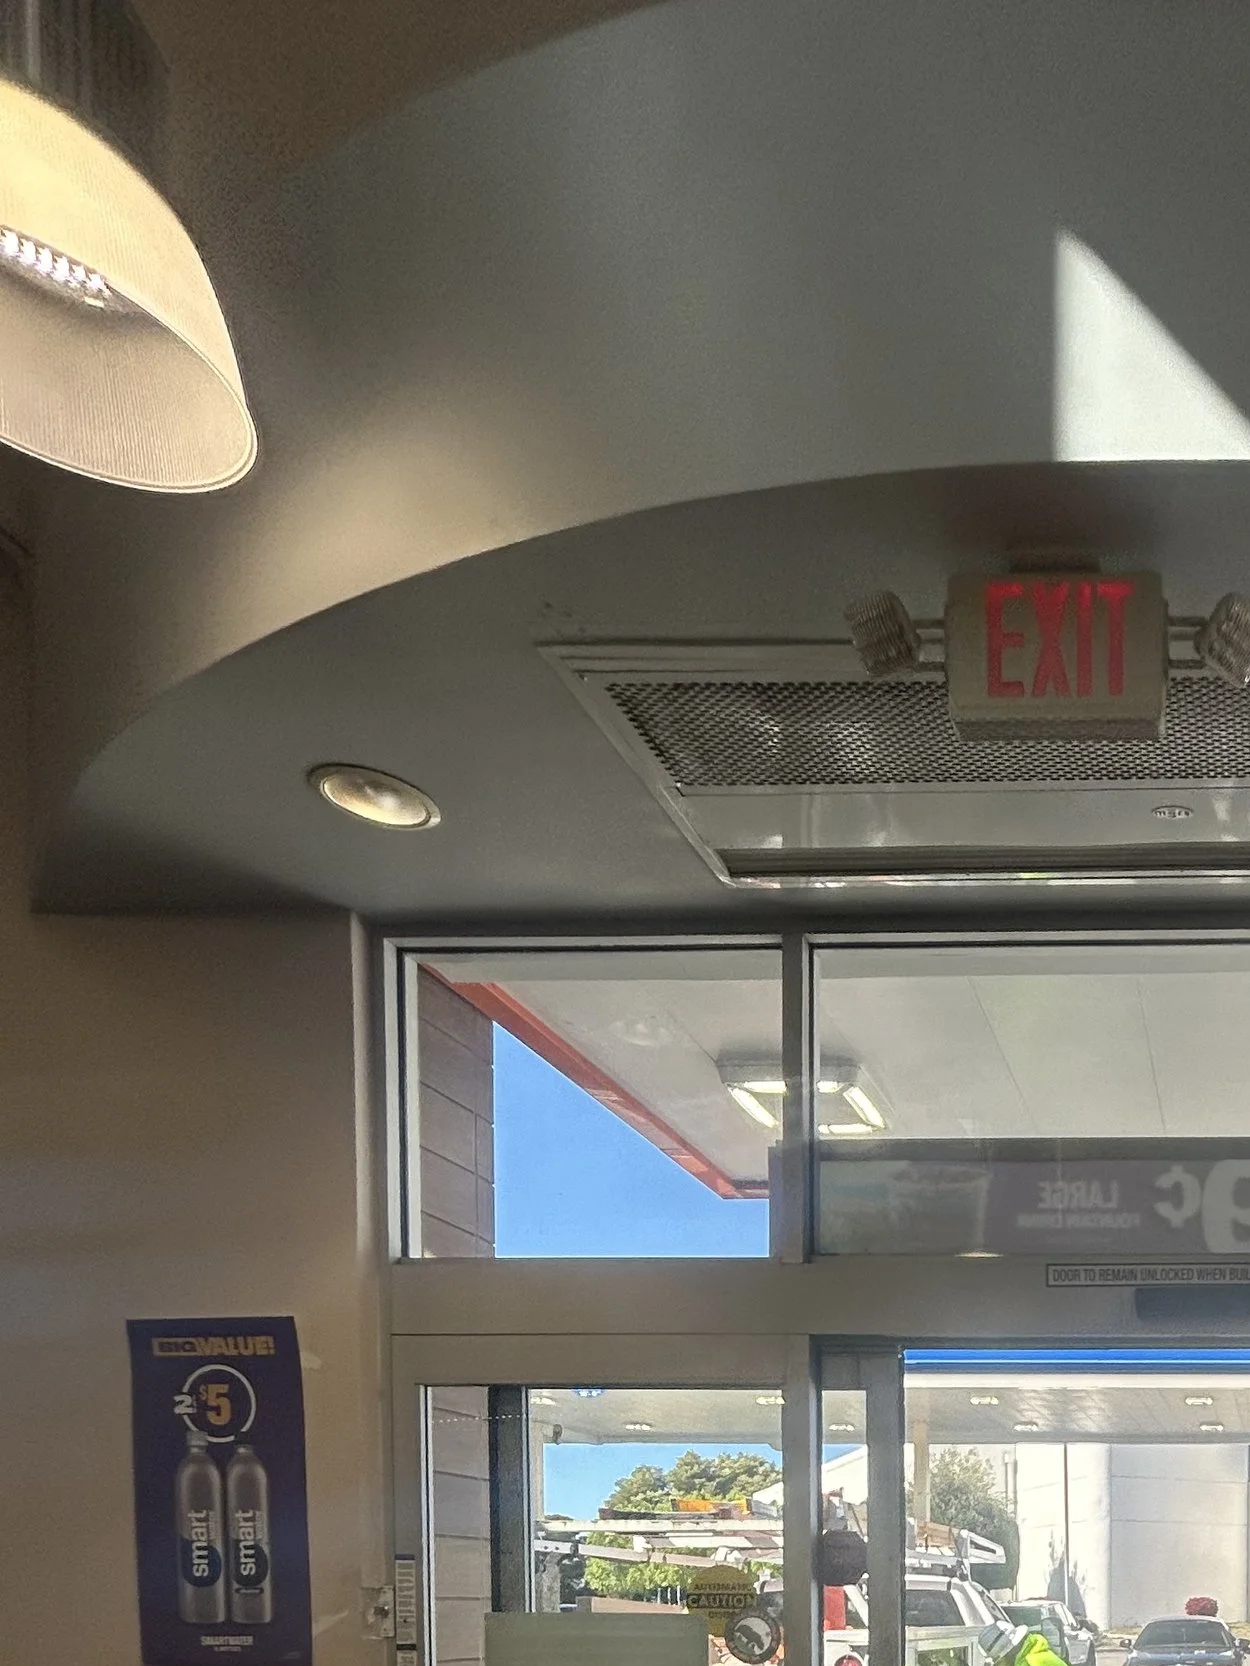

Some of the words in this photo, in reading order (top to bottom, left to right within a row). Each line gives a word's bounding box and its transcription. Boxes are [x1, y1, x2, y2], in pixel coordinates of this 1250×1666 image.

[985, 581, 1134, 698] EXIT
[1052, 1267, 1080, 1282] DOOR
[1083, 1267, 1096, 1282] TO
[1099, 1267, 1137, 1282] REMAIN
[1140, 1267, 1194, 1282] UNLOCKED
[1197, 1267, 1227, 1282] WHEN
[188, 1509, 209, 1577] smart
[235, 1509, 256, 1576] smart
